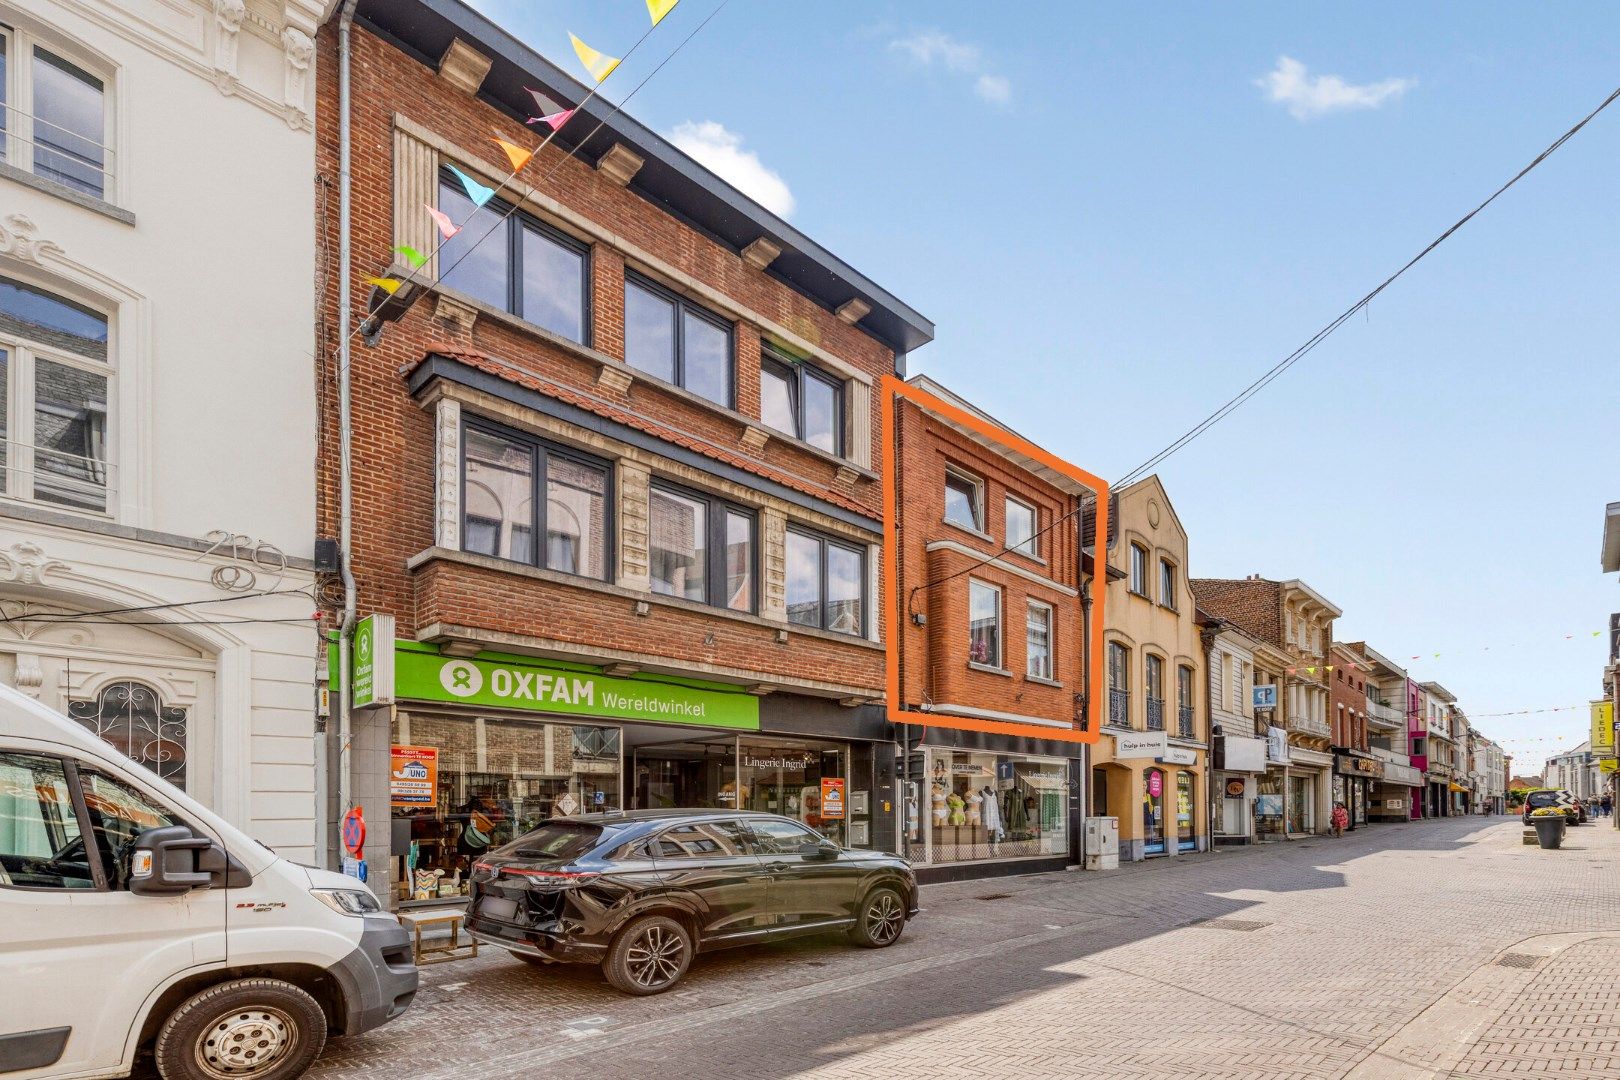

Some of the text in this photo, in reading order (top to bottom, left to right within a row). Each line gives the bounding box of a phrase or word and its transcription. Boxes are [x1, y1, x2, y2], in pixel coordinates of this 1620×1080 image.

[491, 669, 705, 717] OXFAM Wereldwinkel
[745, 756, 806, 770] Lingerie Ingrid
